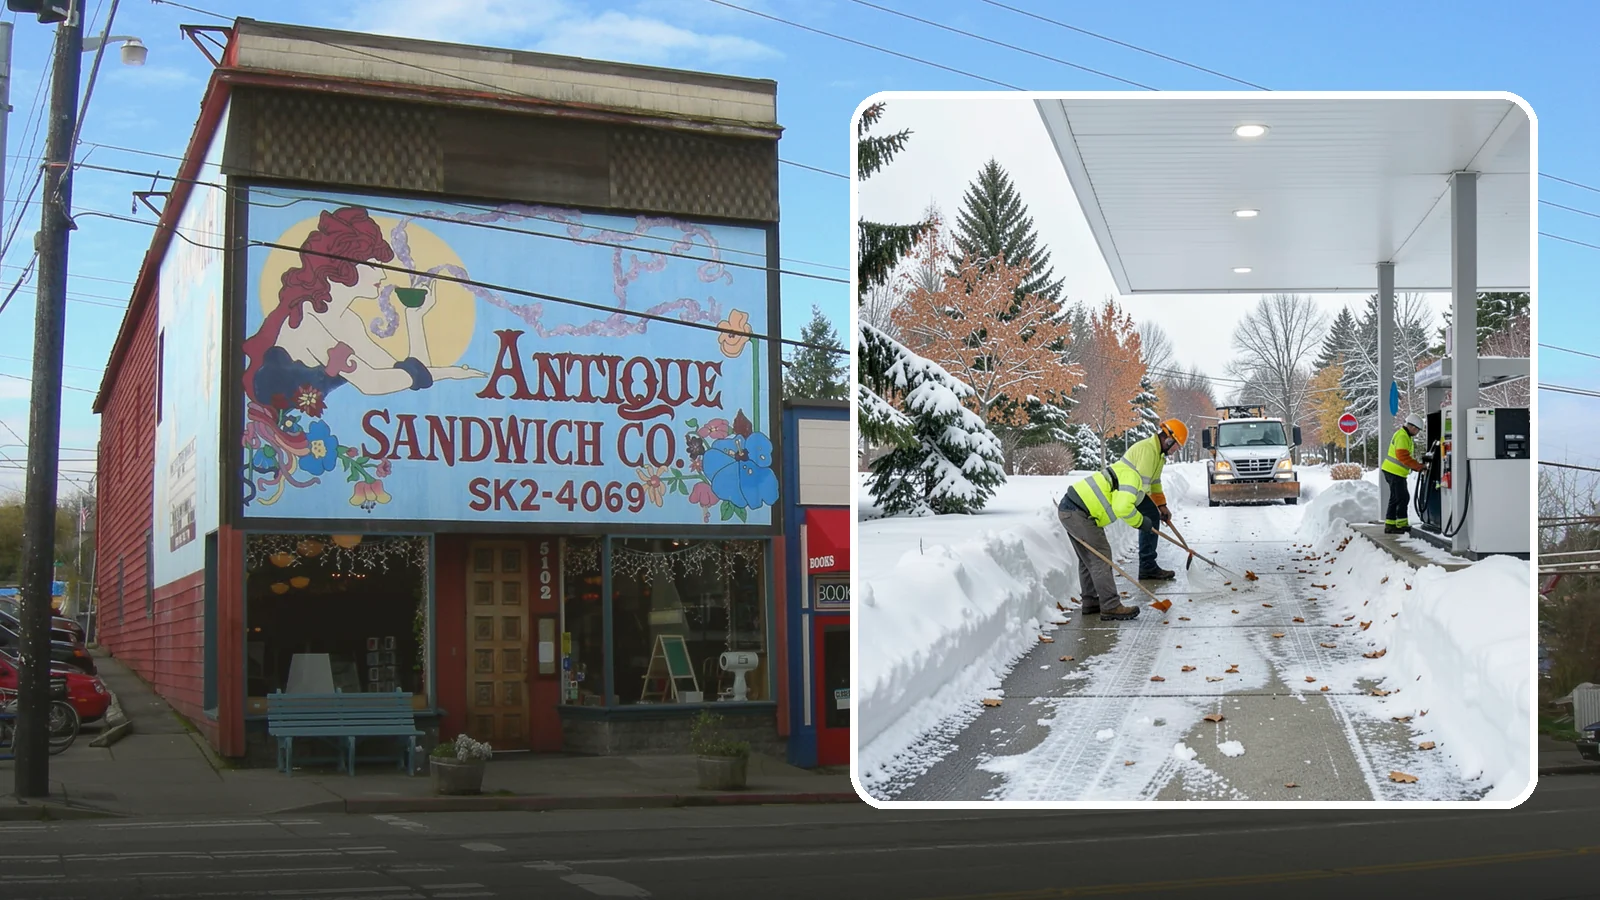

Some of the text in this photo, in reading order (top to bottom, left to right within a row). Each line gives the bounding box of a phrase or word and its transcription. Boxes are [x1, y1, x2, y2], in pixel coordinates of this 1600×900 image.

[475, 329, 724, 420] ANTIQUE
[361, 408, 685, 469] SANDWICH CO.
[468, 477, 646, 513] SK2-4069
[540, 542, 552, 599] 5102
[809, 555, 835, 569] BOOKS
